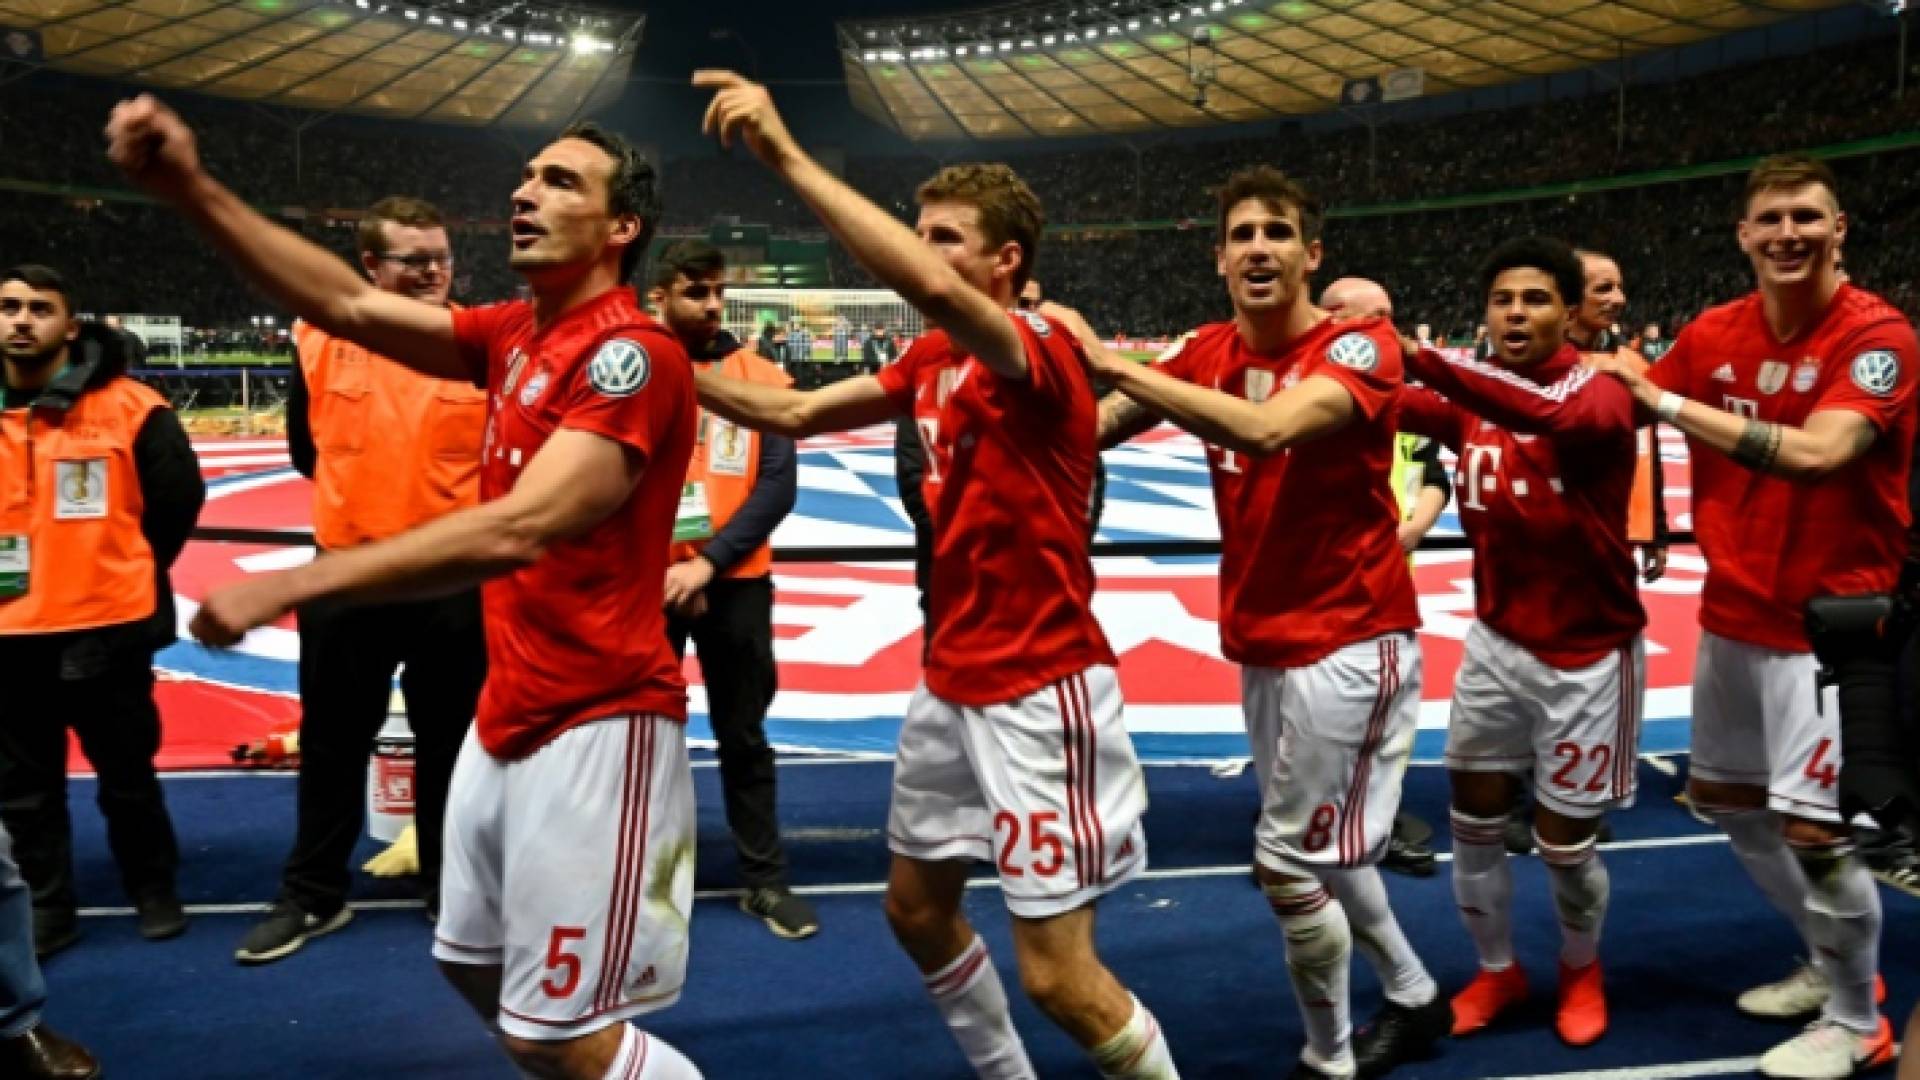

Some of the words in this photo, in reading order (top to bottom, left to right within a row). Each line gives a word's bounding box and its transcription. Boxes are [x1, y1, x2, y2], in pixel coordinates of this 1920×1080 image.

[588, 338, 651, 397] VW
[1550, 740, 1611, 792] 22
[1803, 736, 1839, 789] 4
[993, 809, 1066, 878] 25
[1302, 803, 1336, 853] 8
[541, 926, 587, 999] 5
